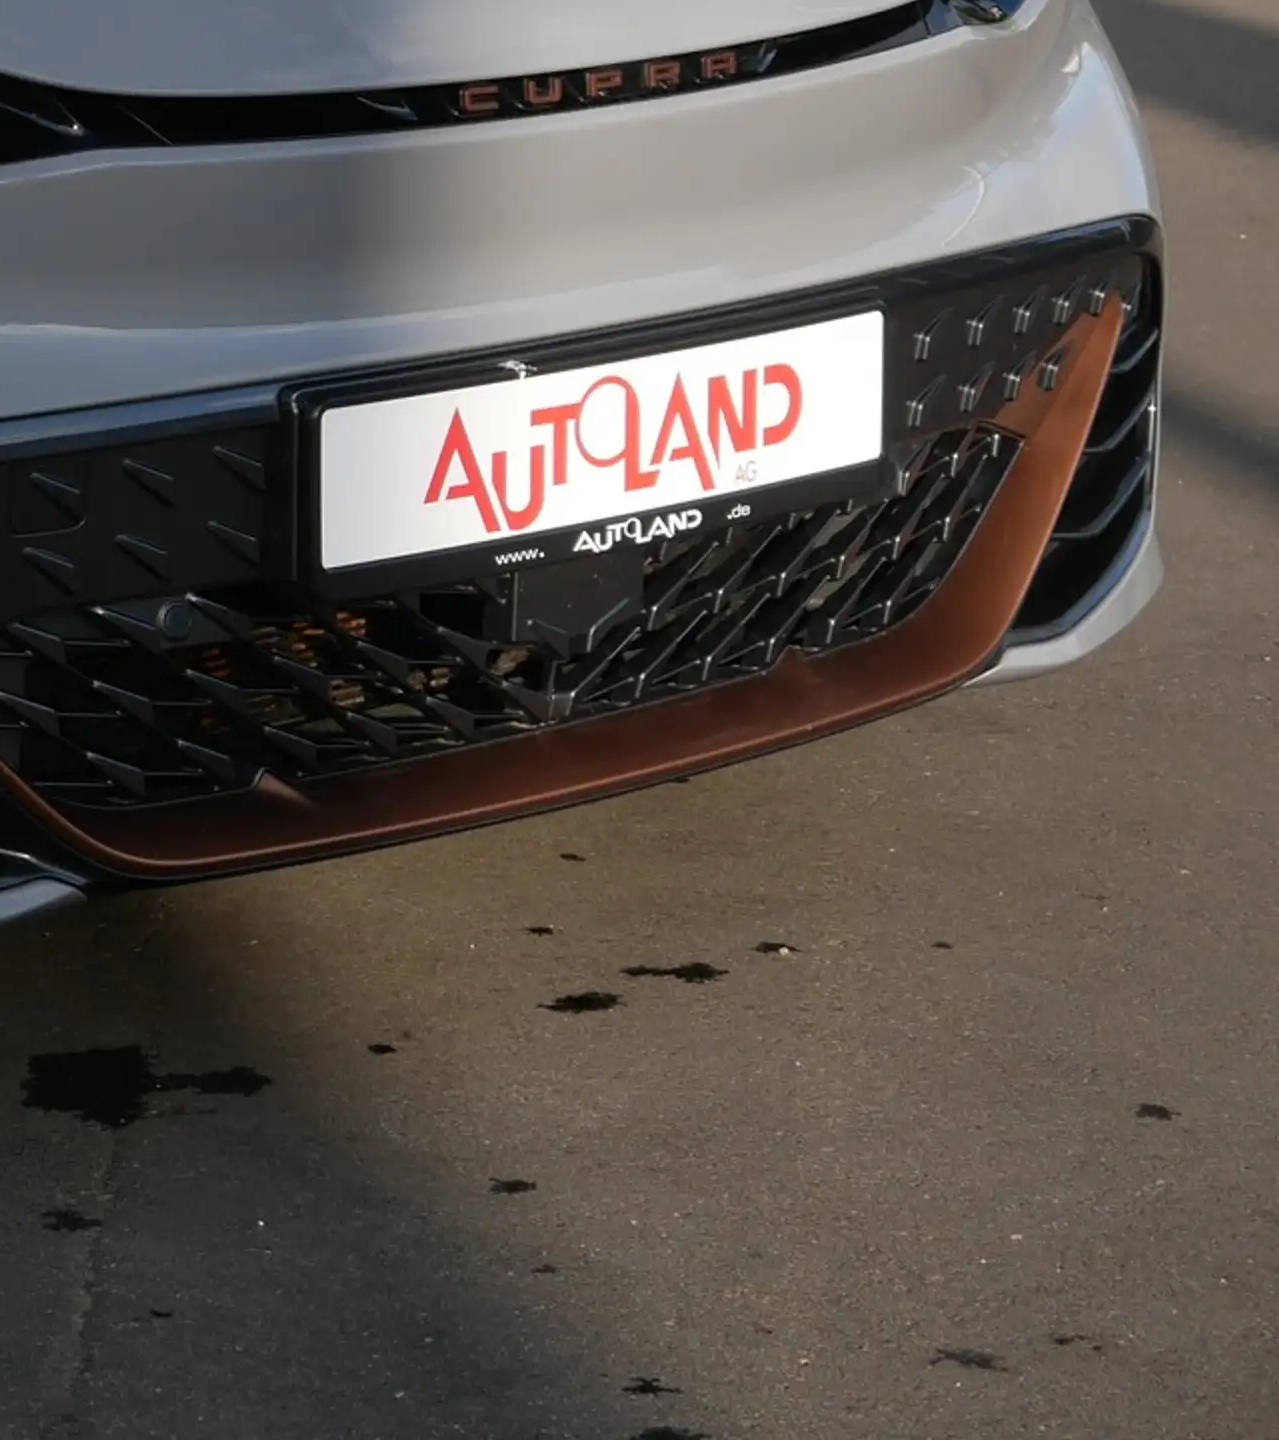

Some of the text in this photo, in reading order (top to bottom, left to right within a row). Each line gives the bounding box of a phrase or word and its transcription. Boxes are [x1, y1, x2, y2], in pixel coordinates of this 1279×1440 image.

[458, 51, 737, 114] CUPRA
[423, 363, 803, 533] AUTOLAND
[735, 461, 758, 482] AG
[572, 508, 703, 554] AUTOLAND
[726, 503, 751, 520] .de
